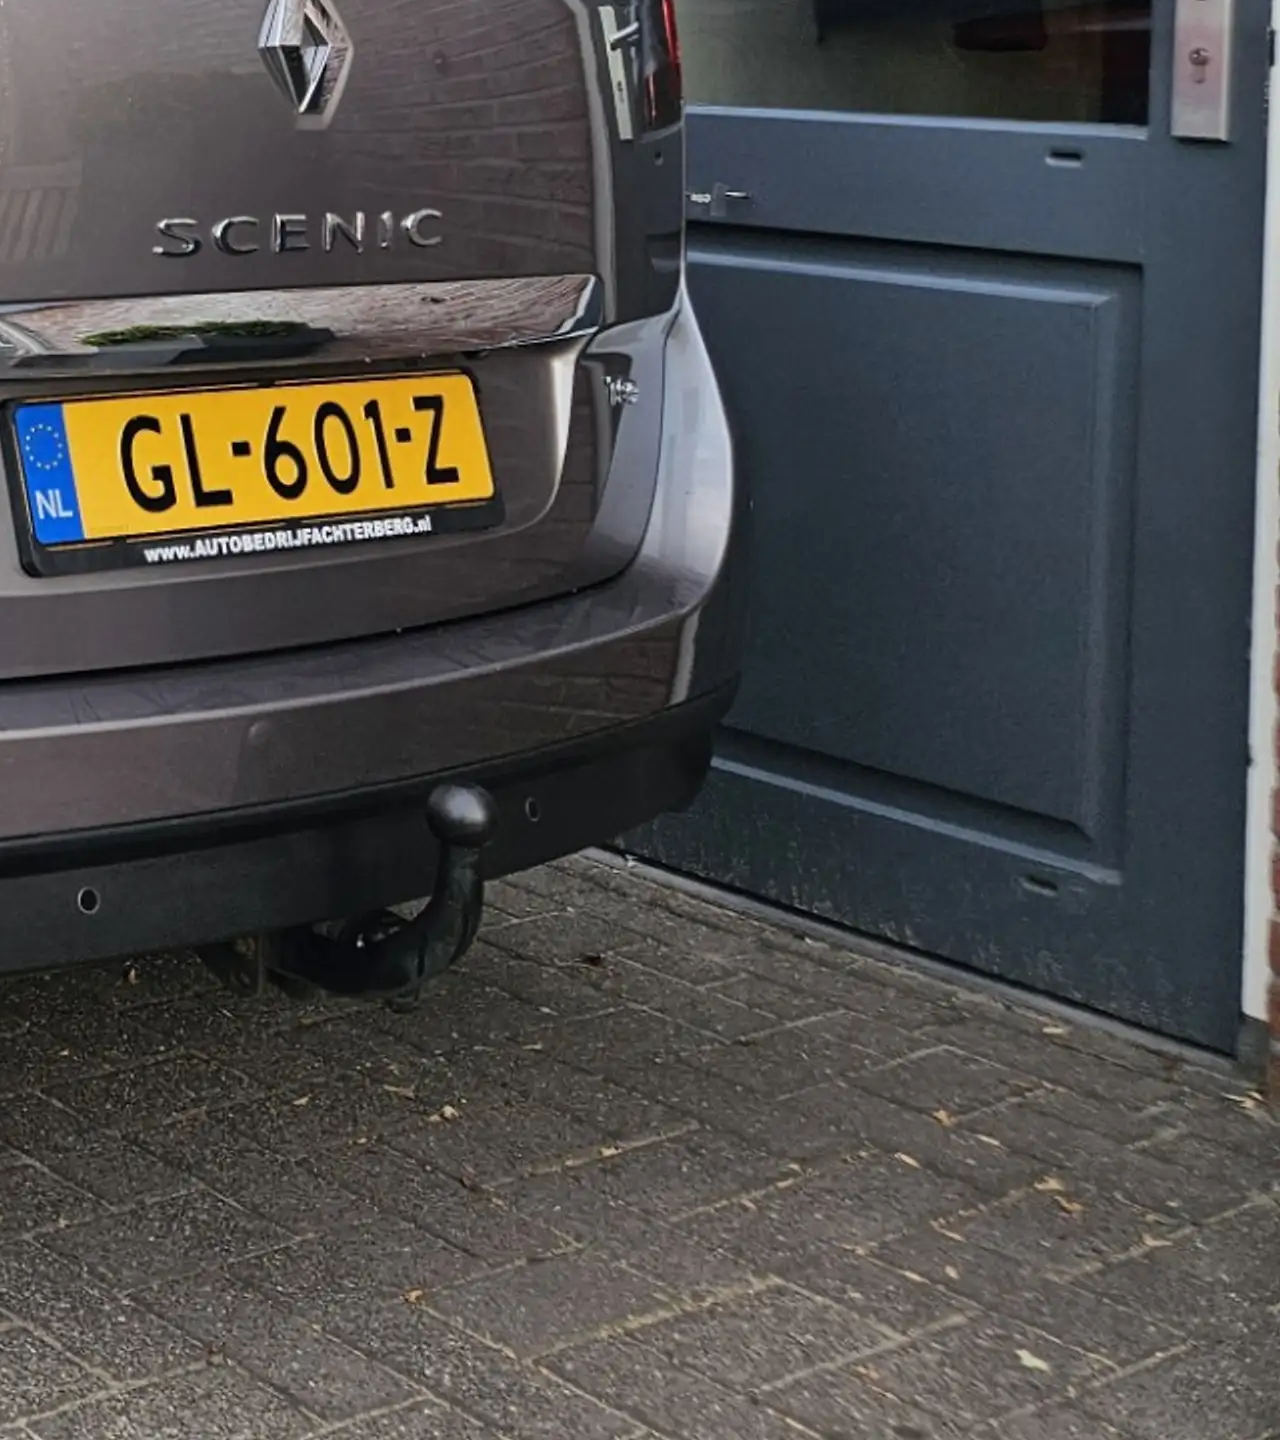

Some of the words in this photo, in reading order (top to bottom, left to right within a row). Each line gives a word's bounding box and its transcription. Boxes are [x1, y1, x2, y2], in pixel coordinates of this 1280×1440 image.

[153, 207, 444, 258] SCENIC
[119, 394, 461, 513] GL-601-Z
[34, 488, 75, 521] NL
[143, 514, 433, 564] www.AUTOBEDRIJFACHTERBERG.nl
